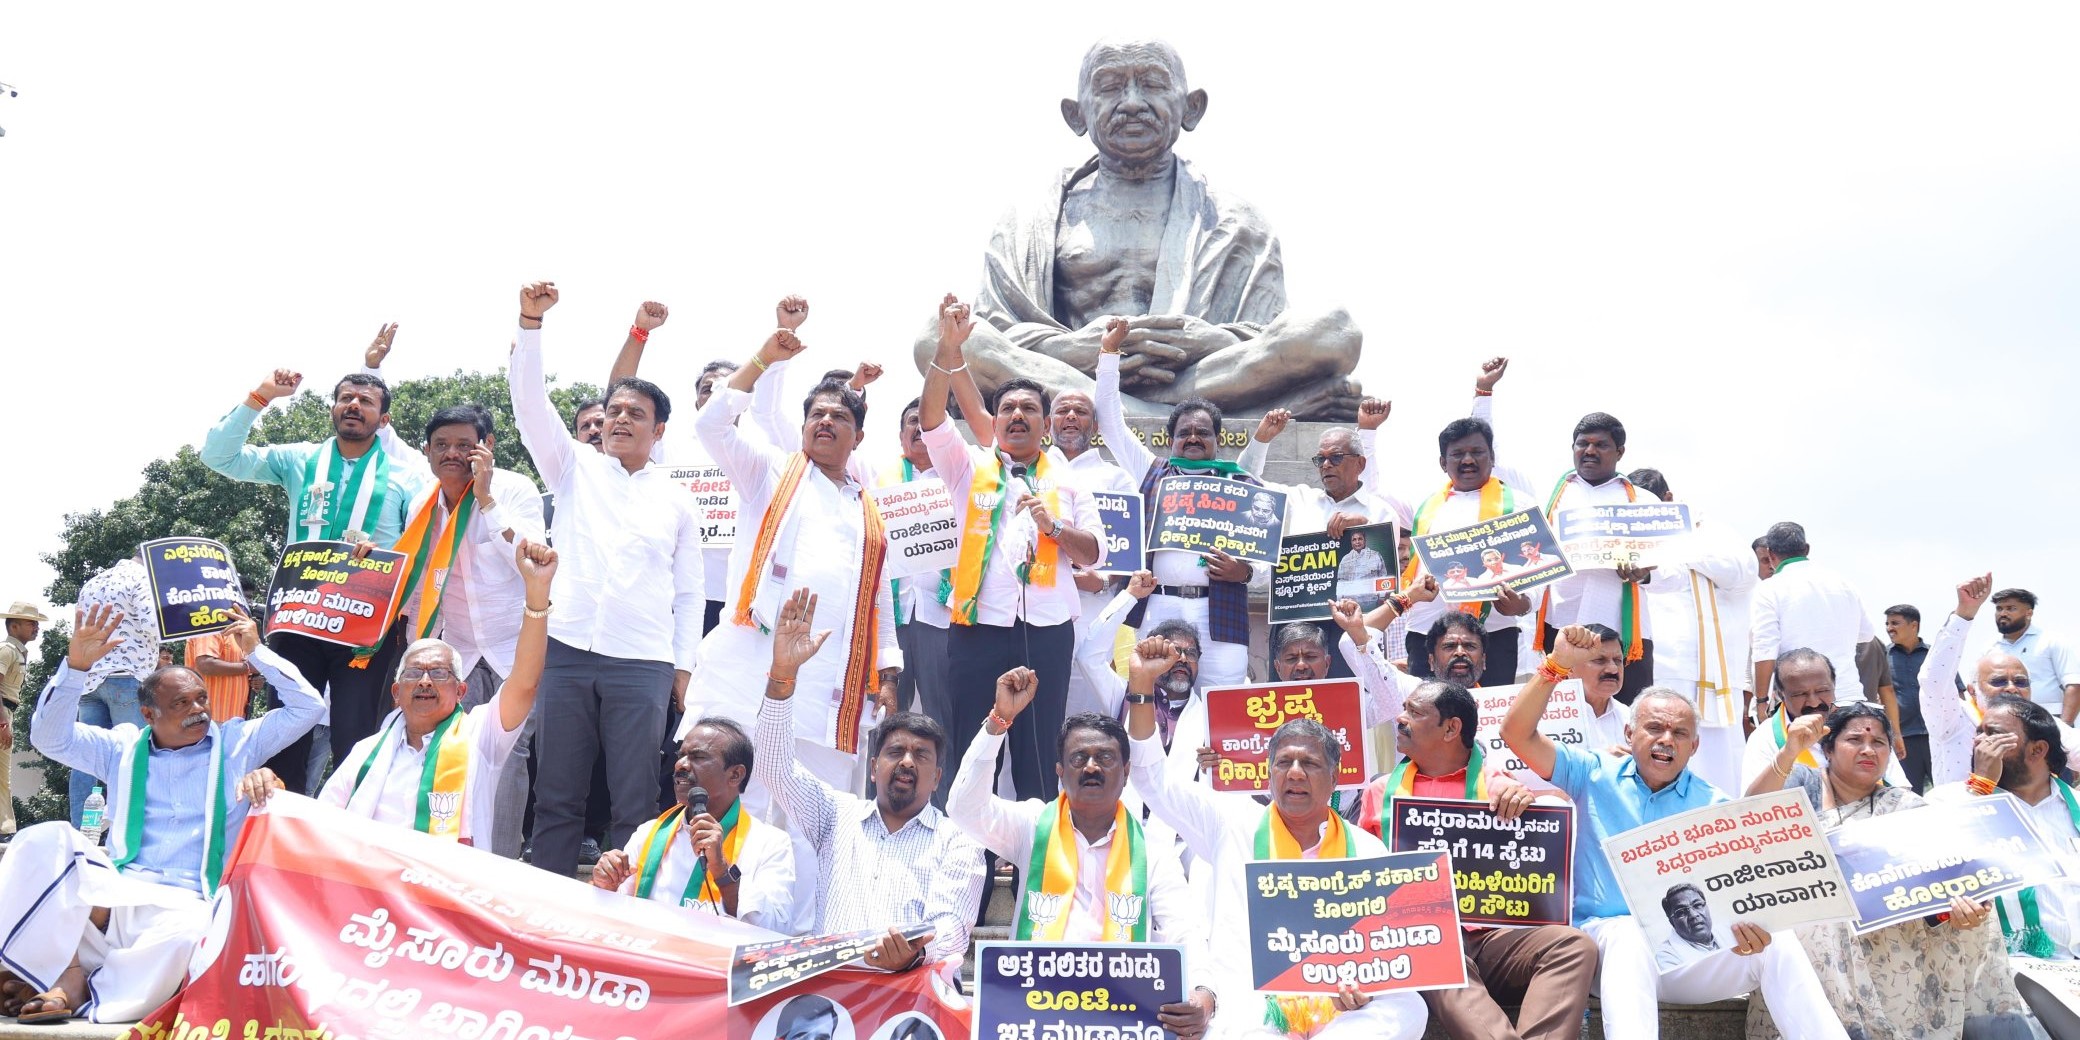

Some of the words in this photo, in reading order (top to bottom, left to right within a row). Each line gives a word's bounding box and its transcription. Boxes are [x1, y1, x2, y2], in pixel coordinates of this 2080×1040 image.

[690, 479, 731, 493] ಕೋಟಿ
[1275, 550, 1337, 573] SCAM
[1620, 831, 1680, 865] ಬಡವರ
[1684, 818, 1737, 844] ಭೂಮಿ
[1741, 802, 1804, 828] ನುಂಗಿದ
[1656, 823, 1813, 876] ಸಿದ್ದರಾಮಯ್ಯನವರೇ
[1472, 843, 1495, 860] 14
[1500, 840, 1546, 870] ಸೈಟು
[1705, 850, 1828, 893] ರಾಜೀನಾಮೆ
[1257, 872, 1299, 899] ಭ್ರಷ್ಟ
[1297, 869, 1372, 896] ಕಾಂಗ್ರೆಸ್
[1375, 862, 1439, 888] ಸರ್ಕಾರ
[1732, 880, 1838, 915] ಯಾವಾಗ?
[1313, 895, 1387, 919] ತೊಲಗಲಿ
[339, 907, 514, 981] ಮೈಸೂರು
[520, 954, 651, 1011] ಮುಡಾ
[1267, 926, 1365, 962] ಮೈಸೂರು
[1369, 924, 1442, 951] ಮುಡಾ
[997, 951, 1036, 988] ಅತ್ತ
[1038, 951, 1104, 978] ದಲಿತರ
[1109, 952, 1166, 990] ದುಡ್ಡು
[1302, 955, 1412, 986] ಉಳಿಯಲಿ
[1026, 988, 1137, 1012] ಲೂಟಿ...
